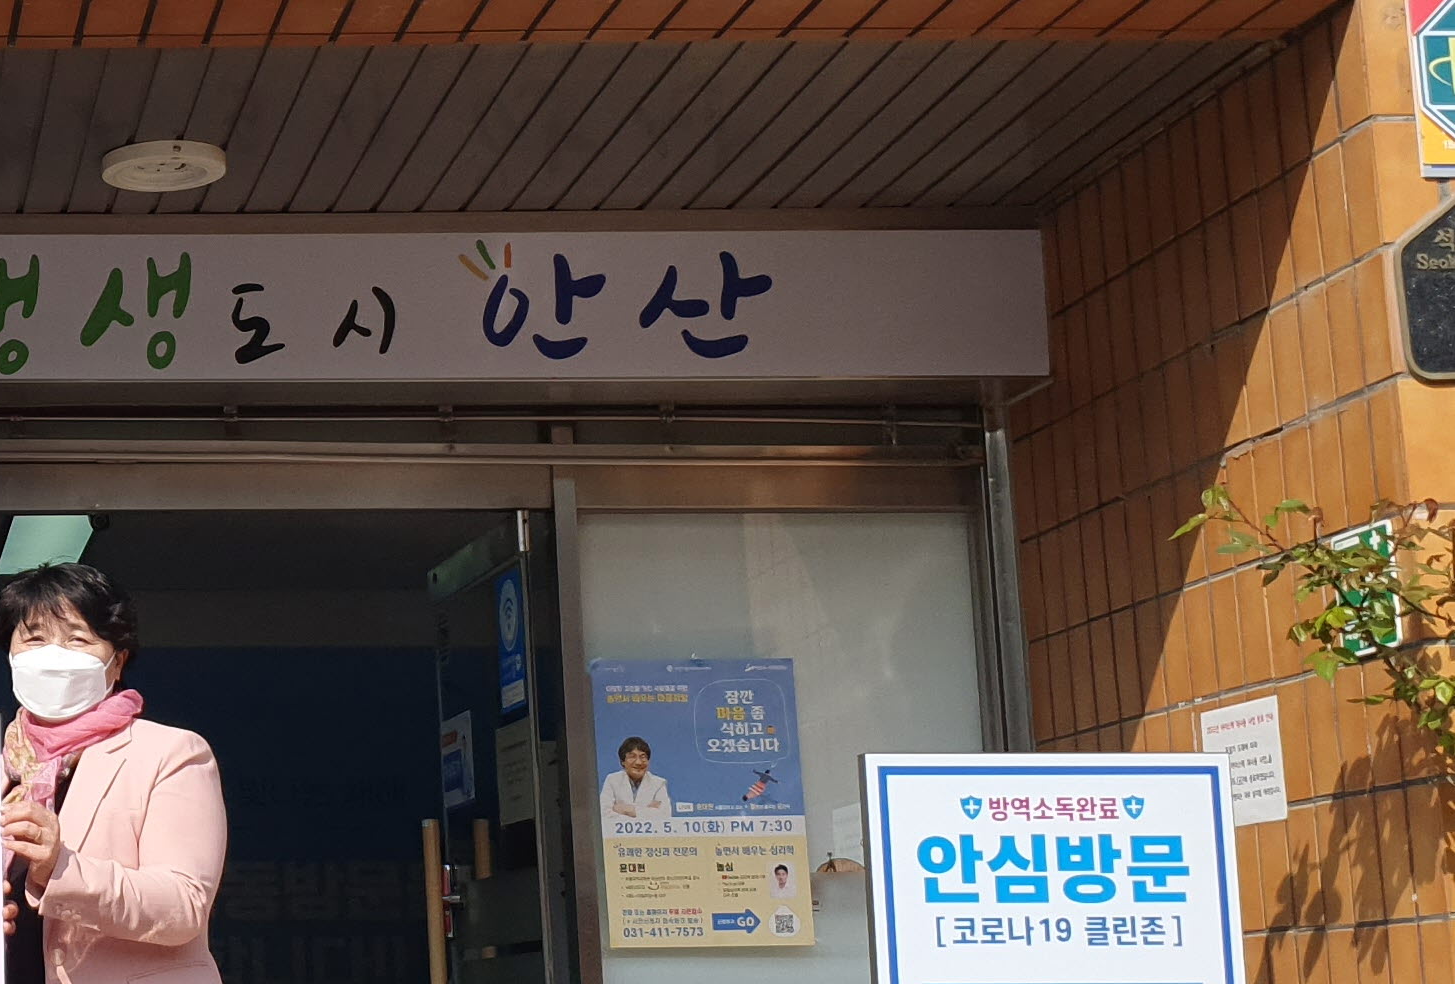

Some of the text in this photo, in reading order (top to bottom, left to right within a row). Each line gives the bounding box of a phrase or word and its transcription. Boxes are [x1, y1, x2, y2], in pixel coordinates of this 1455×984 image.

[482, 251, 773, 359] 안산
[724, 690, 754, 704] 잠깐
[716, 705, 765, 720] 마음 좀
[720, 722, 764, 736] 식히고
[707, 738, 780, 752] 오겠습니다
[989, 796, 1120, 821] 방역소독완료
[615, 822, 658, 834] 2022.
[684, 821, 725, 834] 10(화)
[730, 821, 754, 832] PM
[760, 820, 793, 832] 7:30
[916, 833, 1191, 904] 안심방문
[736, 916, 755, 927] GO
[623, 927, 704, 938] 031-411-7573
